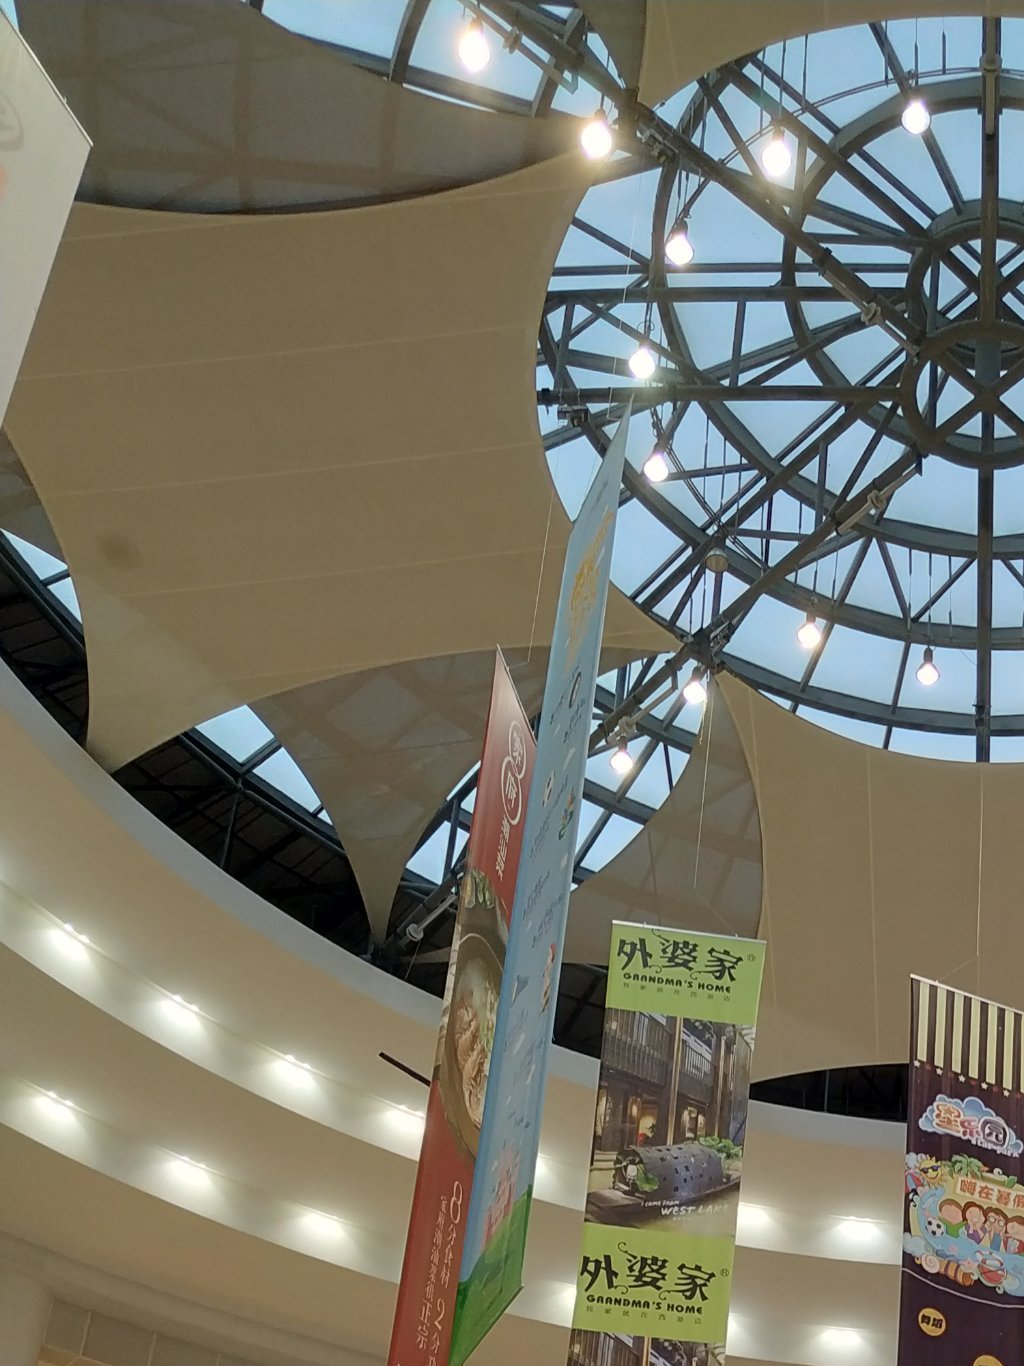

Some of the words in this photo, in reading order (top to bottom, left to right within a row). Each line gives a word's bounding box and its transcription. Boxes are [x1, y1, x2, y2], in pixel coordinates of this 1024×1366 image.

[616, 932, 744, 982] 外婆家
[623, 973, 693, 988] GRANDMA'S
[698, 982, 731, 994] HOME
[661, 1206, 696, 1215] WEST
[580, 1244, 716, 1301] 外婆家
[586, 1294, 662, 1310] GRANDMA'S
[667, 1303, 703, 1315] HOME
